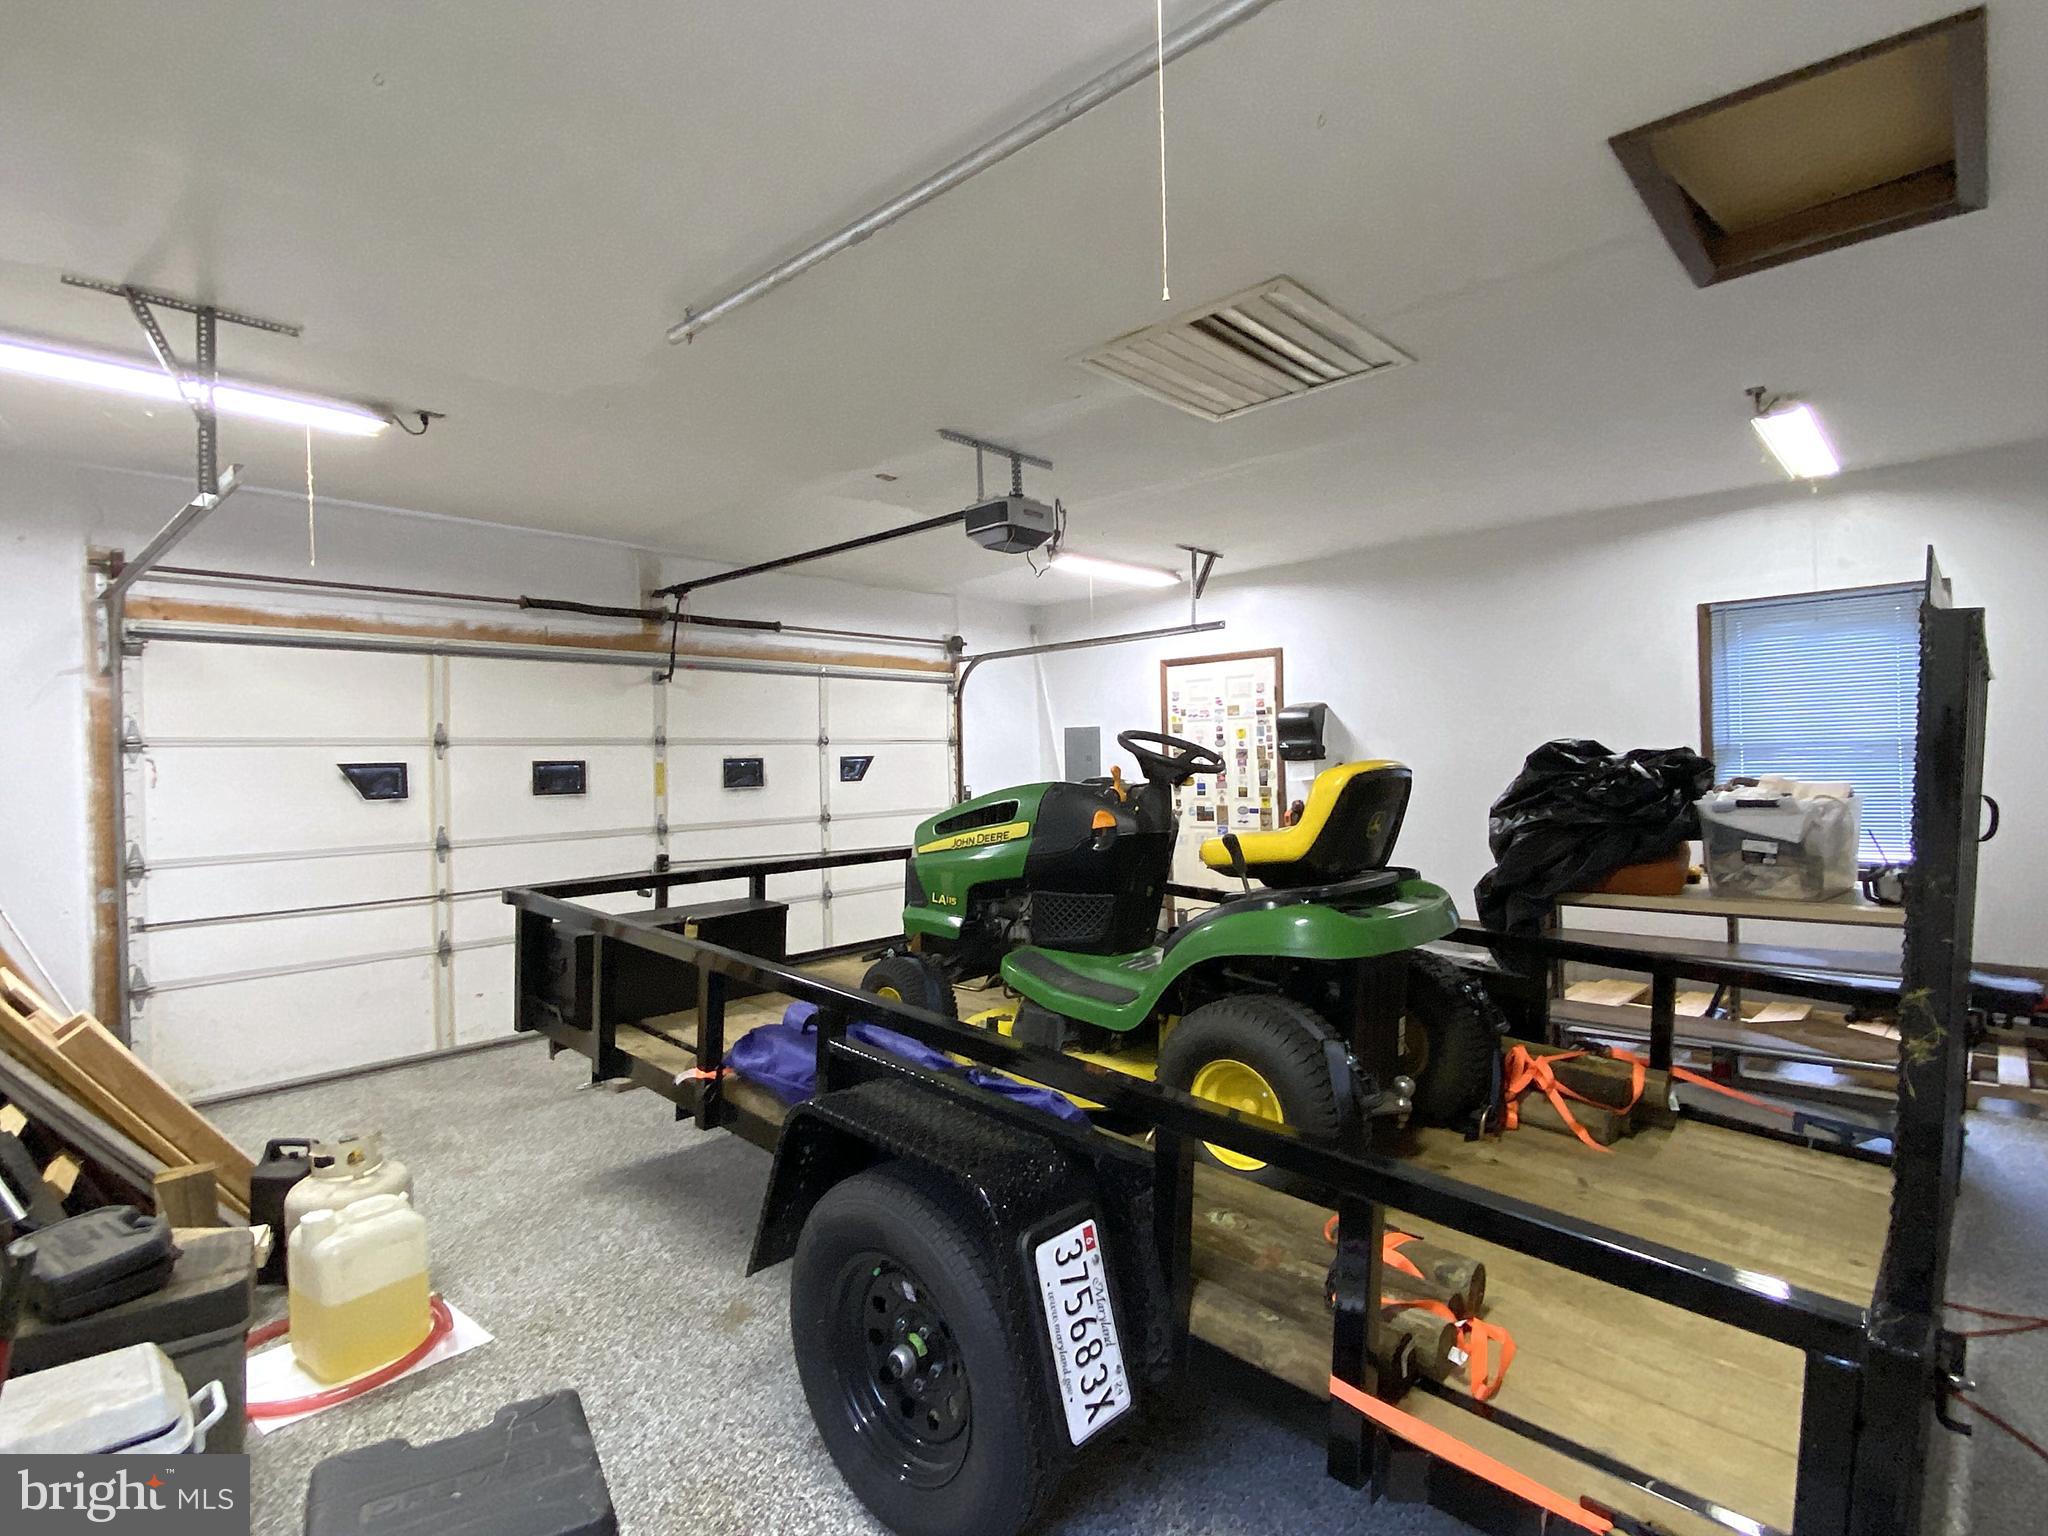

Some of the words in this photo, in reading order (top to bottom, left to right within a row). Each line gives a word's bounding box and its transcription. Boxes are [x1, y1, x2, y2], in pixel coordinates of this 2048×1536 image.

[952, 835, 975, 848] JOHN
[977, 831, 1010, 843] DEERE
[1055, 1238, 1115, 1425] 375683X
[1092, 1277, 1116, 1347] Maryland
